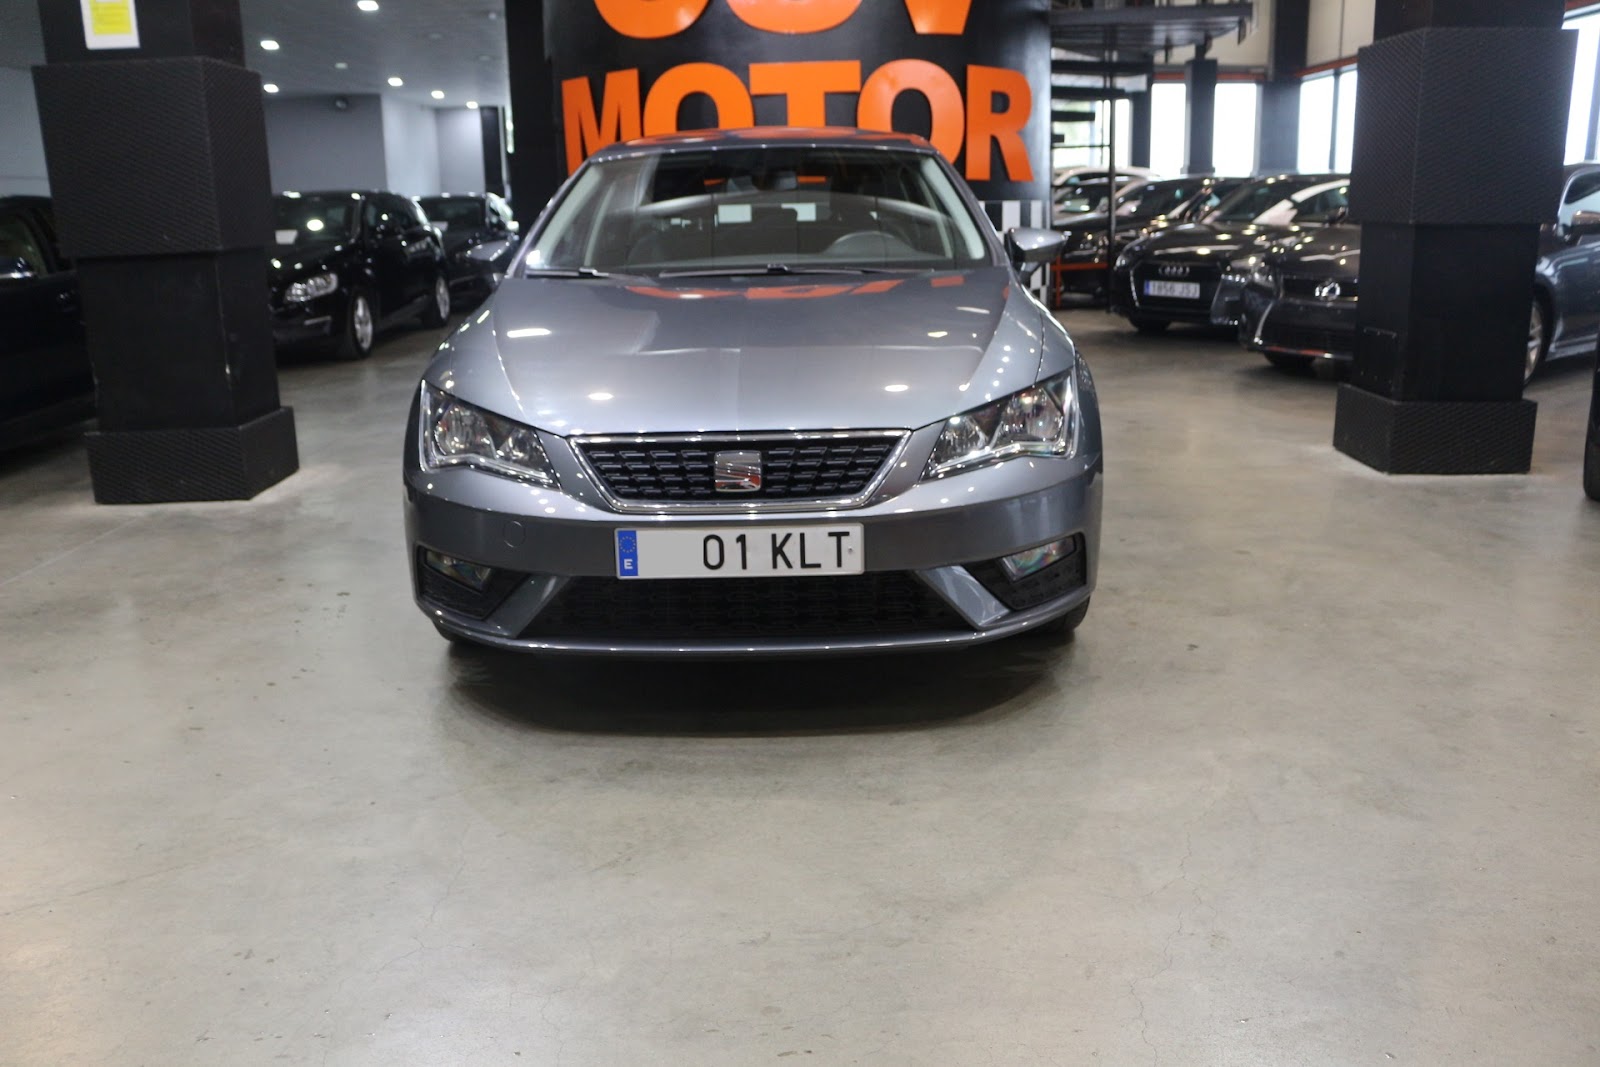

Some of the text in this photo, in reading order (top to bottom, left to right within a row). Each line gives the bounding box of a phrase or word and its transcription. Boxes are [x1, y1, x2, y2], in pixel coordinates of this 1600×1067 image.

[561, 59, 1034, 182] MOTOR
[623, 558, 634, 570] E
[703, 531, 850, 570] 01 KLT
